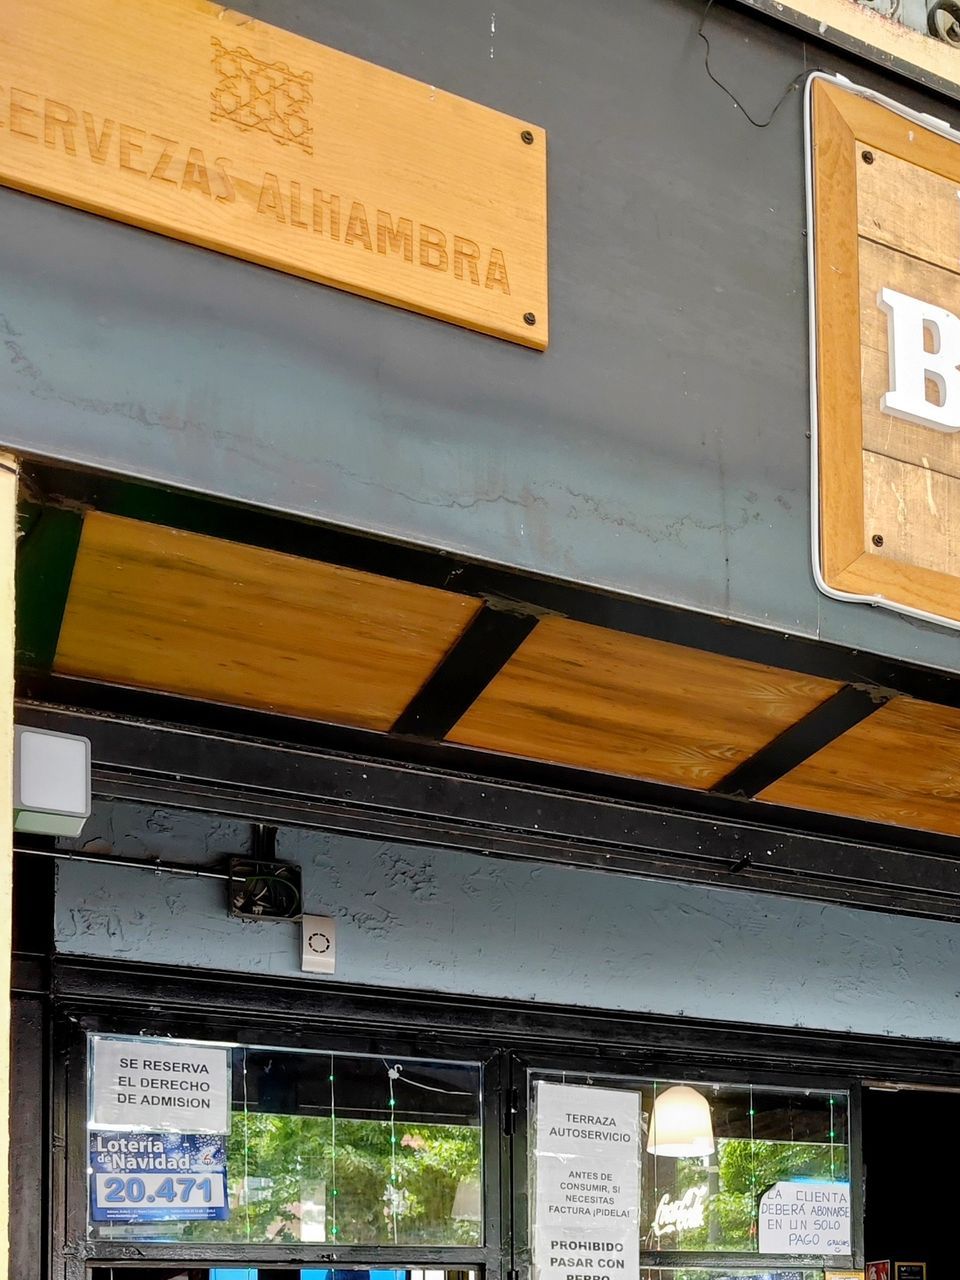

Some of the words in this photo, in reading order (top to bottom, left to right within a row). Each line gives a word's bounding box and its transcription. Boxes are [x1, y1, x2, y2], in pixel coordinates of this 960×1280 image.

[0, 86, 238, 204] ERVEZAS
[256, 172, 512, 296] ALHAMBRA
[120, 1058, 138, 1069] SE
[143, 1059, 209, 1074] RESERVA
[118, 1076, 136, 1087] EL
[140, 1077, 210, 1092] DERECHO
[117, 1093, 137, 1105] DE
[141, 1094, 211, 1109] ADMISION
[566, 1113, 617, 1127] TERRAZA
[549, 1128, 631, 1143] AUTOSERVICIO
[97, 1136, 164, 1153] Lotería
[97, 1153, 112, 1164] de
[111, 1154, 190, 1170] Navidad
[568, 1170, 599, 1181] ANTES
[601, 1172, 613, 1182] DE
[104, 1176, 212, 1203] 20.471
[560, 1182, 610, 1194] CONSUMIR,
[612, 1184, 621, 1194] SI
[565, 1194, 615, 1205] NECESITAS
[767, 1189, 783, 1200] LA
[795, 1190, 848, 1204] CUENTA
[548, 1205, 591, 1216] FACTURA
[593, 1207, 630, 1218] ¡PIDELA!
[761, 1202, 806, 1216] DEBERÁ
[810, 1205, 850, 1218] ABONARSE
[767, 1218, 783, 1230] EN
[789, 1219, 808, 1231] UN
[813, 1220, 841, 1231] SOLO
[551, 1240, 624, 1253] PROHIBIDO
[788, 1233, 820, 1247] PAGO
[550, 1257, 594, 1268] PASAR
[597, 1258, 625, 1269] CON
